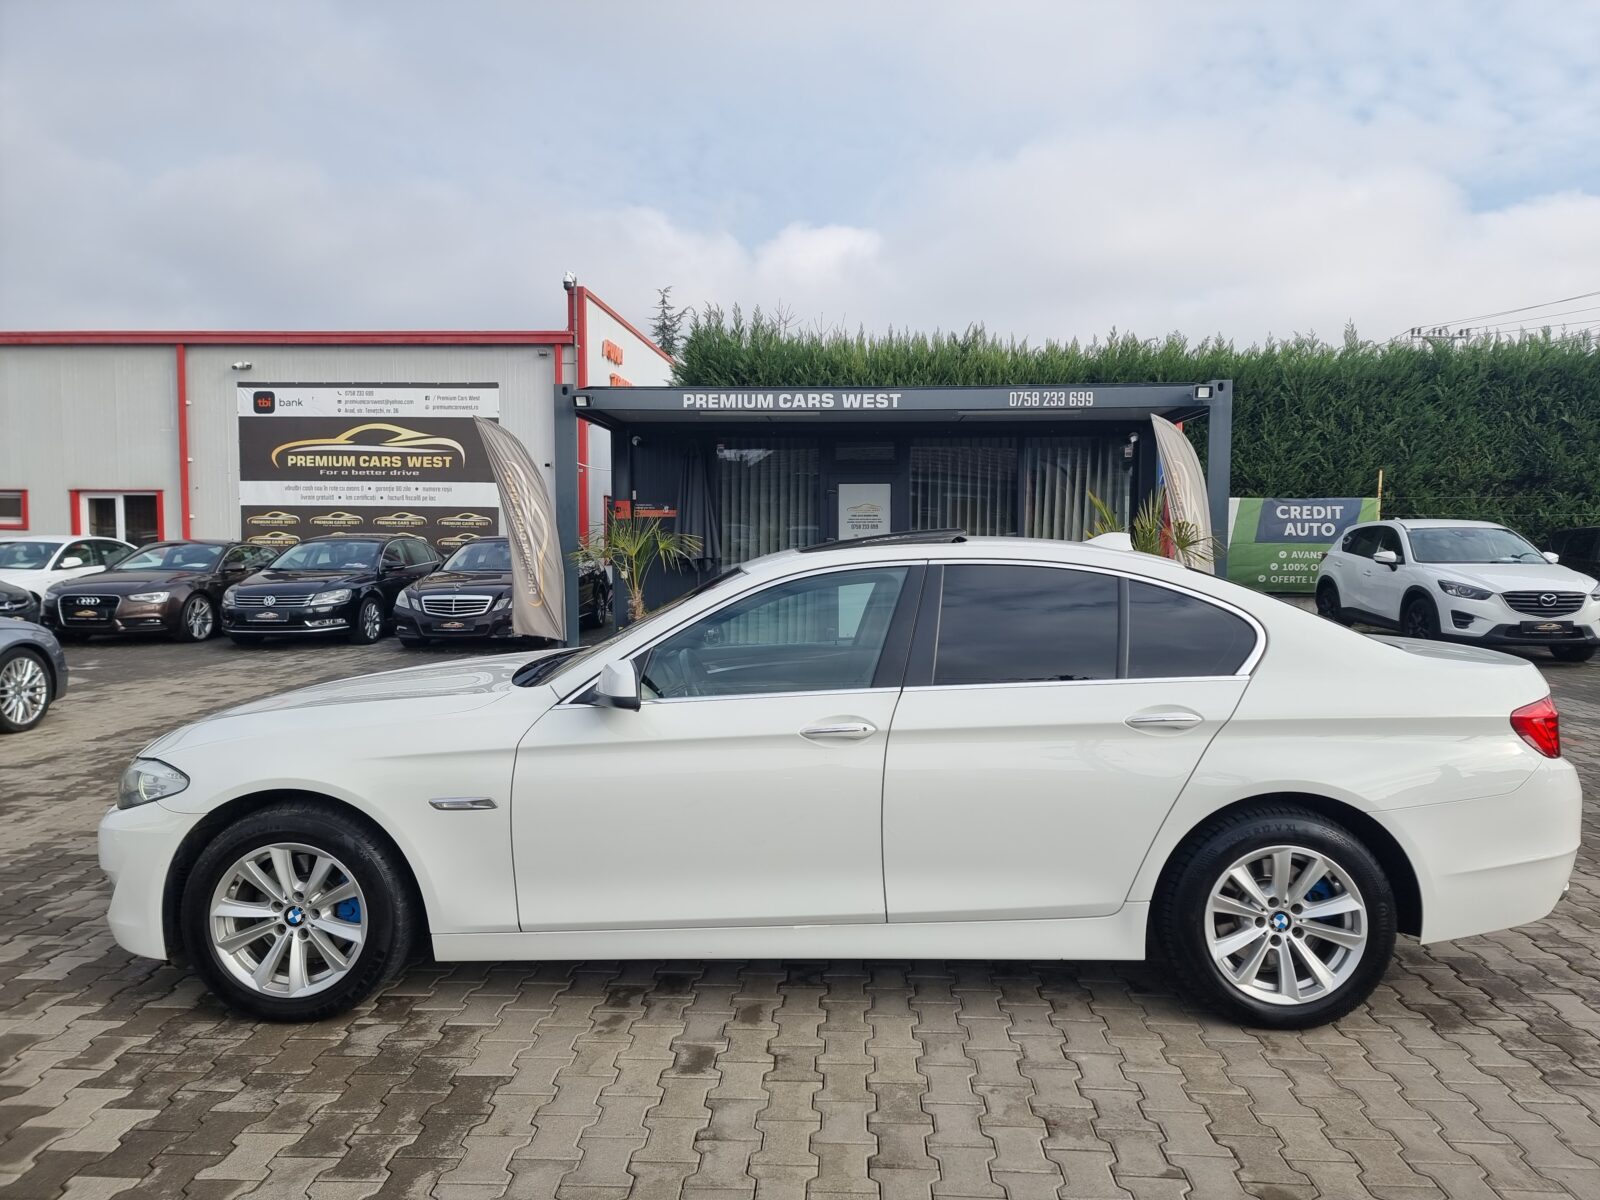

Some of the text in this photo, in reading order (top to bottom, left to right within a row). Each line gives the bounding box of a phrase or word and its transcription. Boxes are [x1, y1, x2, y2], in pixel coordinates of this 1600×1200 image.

[258, 398, 304, 407] tbi bank
[683, 394, 901, 408] PREMIUM CARS WEST
[1009, 392, 1094, 406] 0758 233 699
[288, 455, 452, 467] PREMIUM CARS WEST
[1276, 505, 1344, 519] CREDIT
[1284, 522, 1336, 536] AUTO
